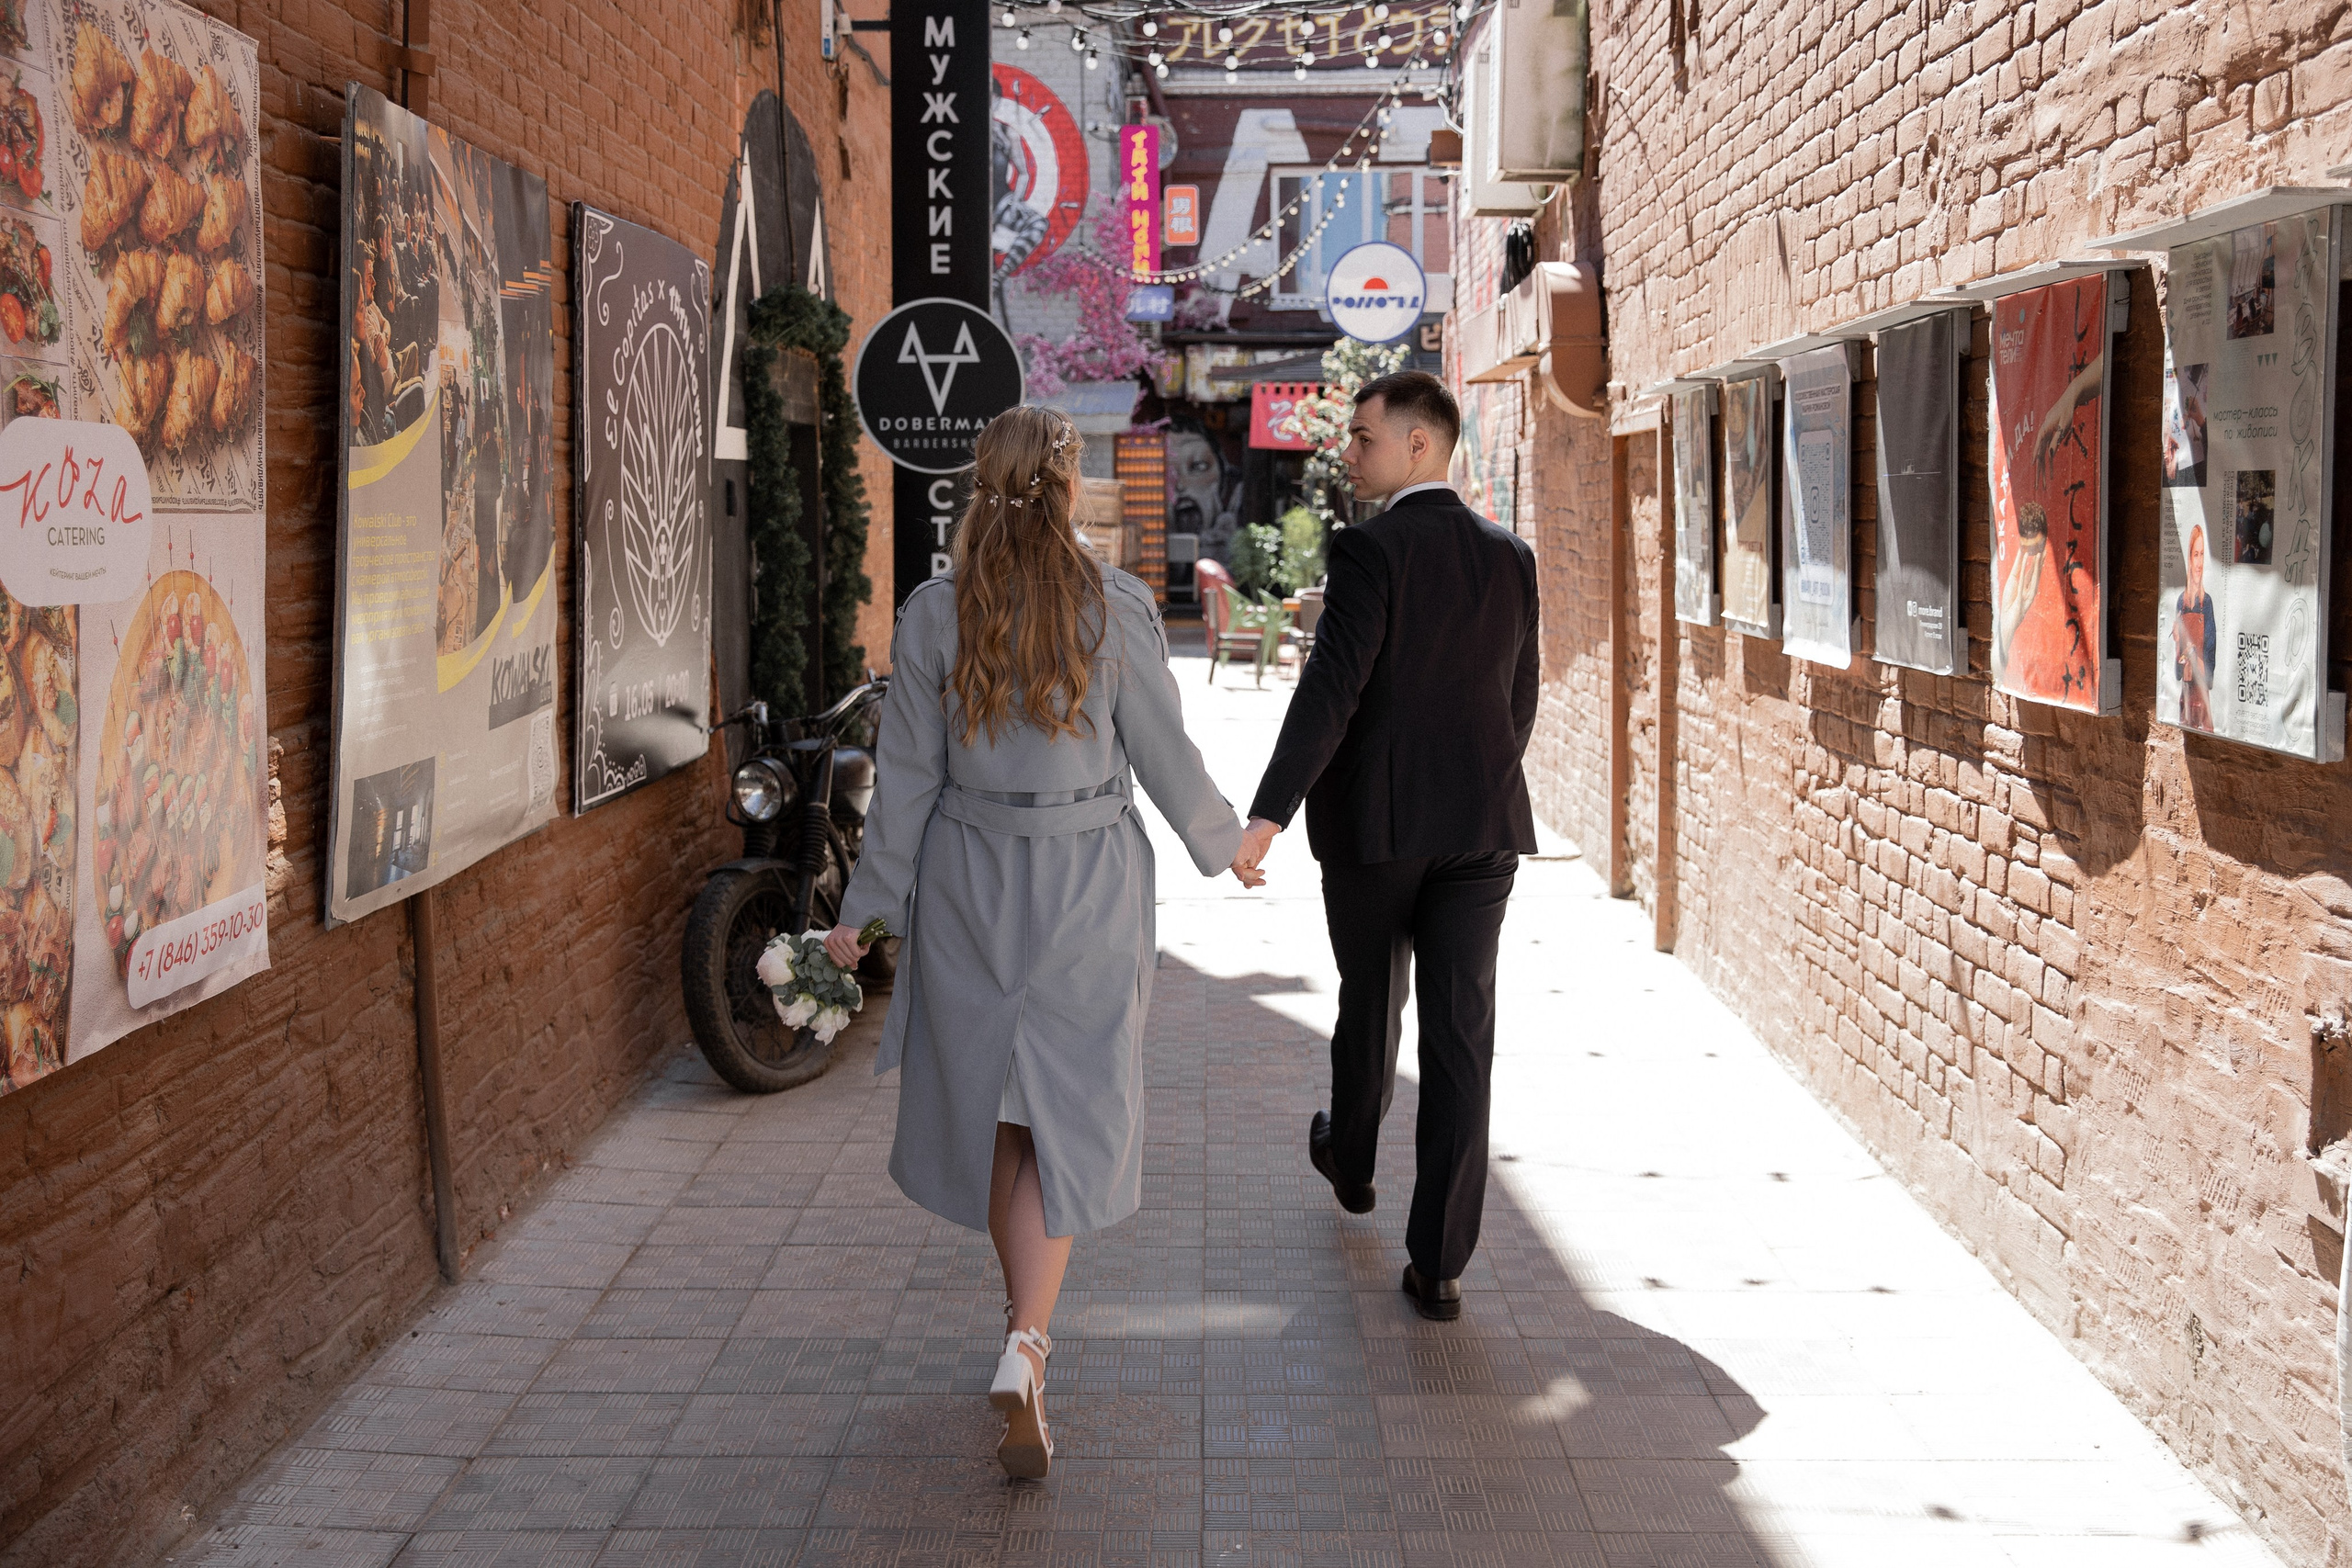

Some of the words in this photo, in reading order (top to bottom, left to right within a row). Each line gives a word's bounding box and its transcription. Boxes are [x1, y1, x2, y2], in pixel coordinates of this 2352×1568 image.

[920, 16, 960, 275] МУЖСКИЕ
[879, 417, 992, 431] DOBERMA
[354, 513, 386, 528] Kowalski
[48, 527, 105, 546] CATERING
[353, 535, 407, 551] универсальное
[139, 949, 154, 981] +7
[157, 931, 198, 979] (846)
[201, 902, 264, 955] 359-10-30
